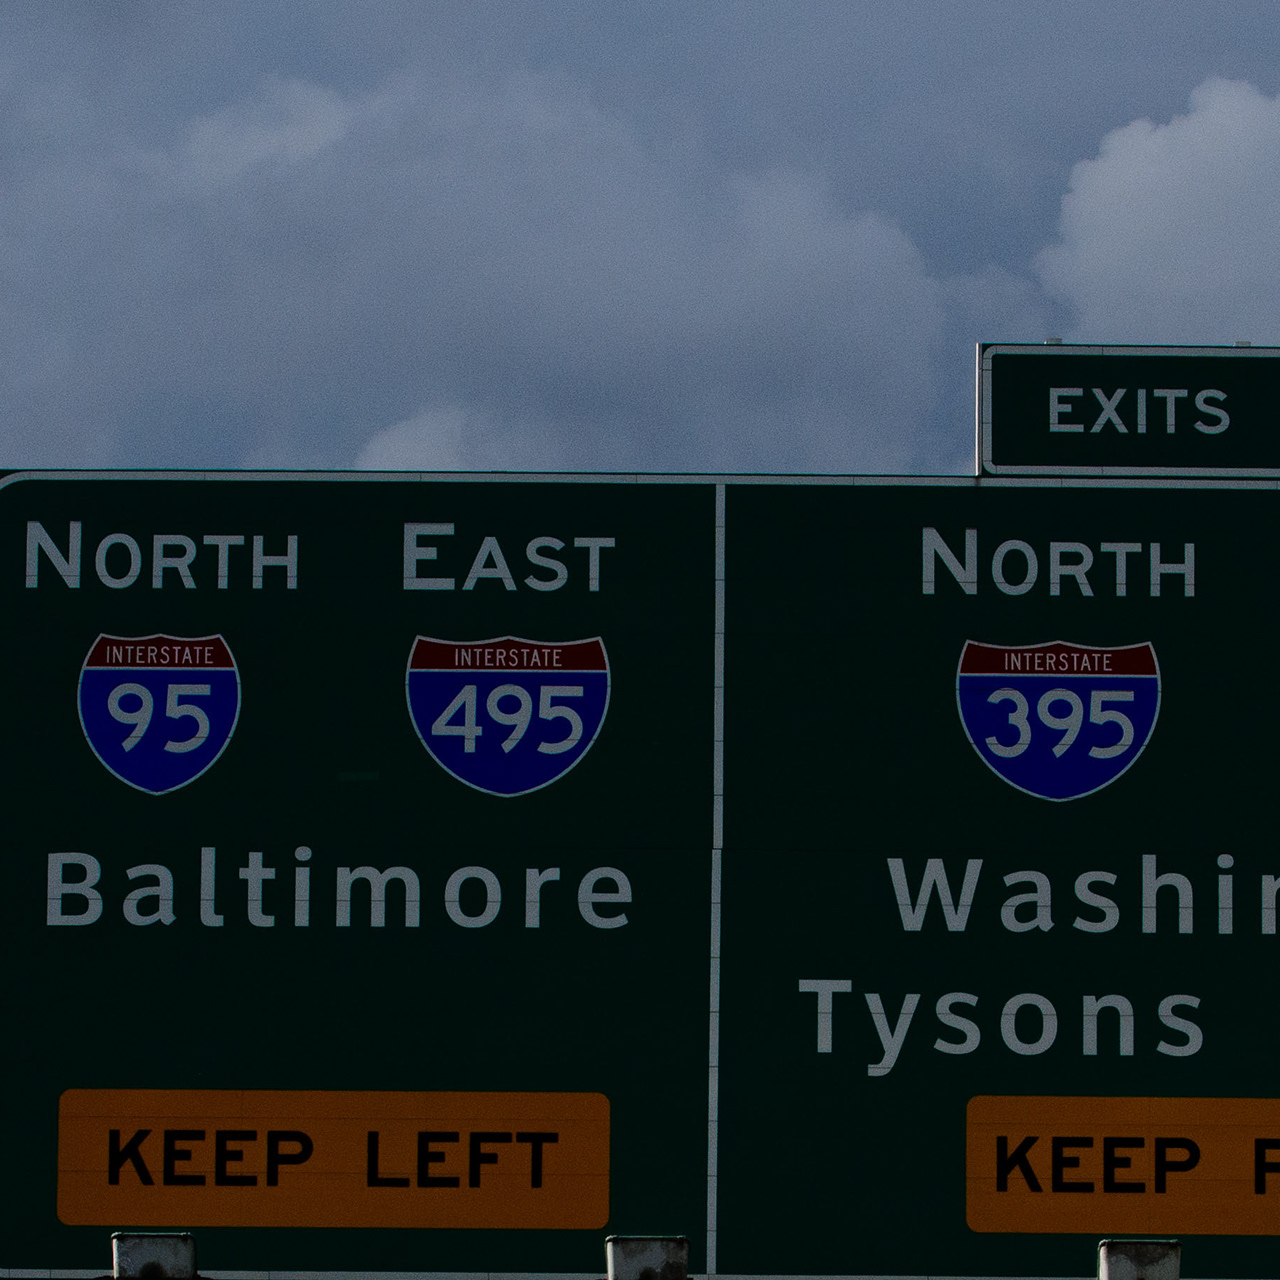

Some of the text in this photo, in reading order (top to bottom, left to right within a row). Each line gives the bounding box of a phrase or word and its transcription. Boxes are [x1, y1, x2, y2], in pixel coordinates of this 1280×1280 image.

[1050, 388, 1229, 433] EXITS
[26, 521, 615, 590] NORTH EAST
[923, 528, 1194, 596] NORTH
[106, 645, 214, 665] INTERSTATE
[455, 647, 563, 667] INTERSTATE
[1004, 652, 1113, 673] INTERSTATE
[108, 683, 209, 752] 95
[431, 684, 585, 754] 495
[984, 688, 1137, 760] 395
[47, 847, 631, 928] Baltimore
[799, 980, 1202, 1076] Tysons
[108, 1129, 558, 1188] KEEP LEFT
[997, 1136, 1200, 1193] KEEP
